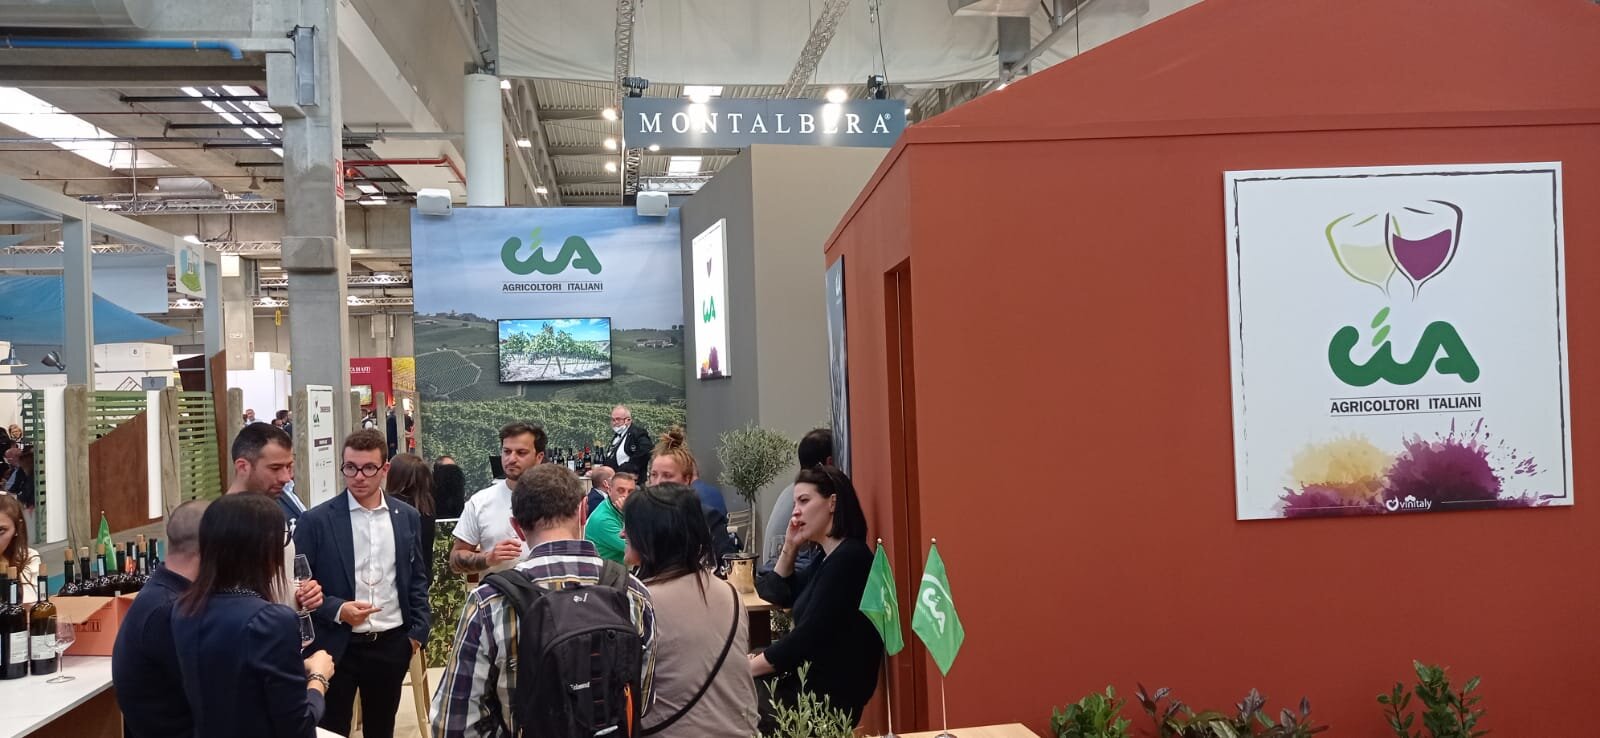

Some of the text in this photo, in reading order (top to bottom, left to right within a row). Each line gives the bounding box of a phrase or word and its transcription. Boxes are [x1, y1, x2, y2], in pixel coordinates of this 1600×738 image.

[502, 282, 604, 292] AGRICOLTORI ITALIANI
[1330, 396, 1482, 414] AGRICOLTORI ITALIANI
[1399, 497, 1433, 510] vinitaly
